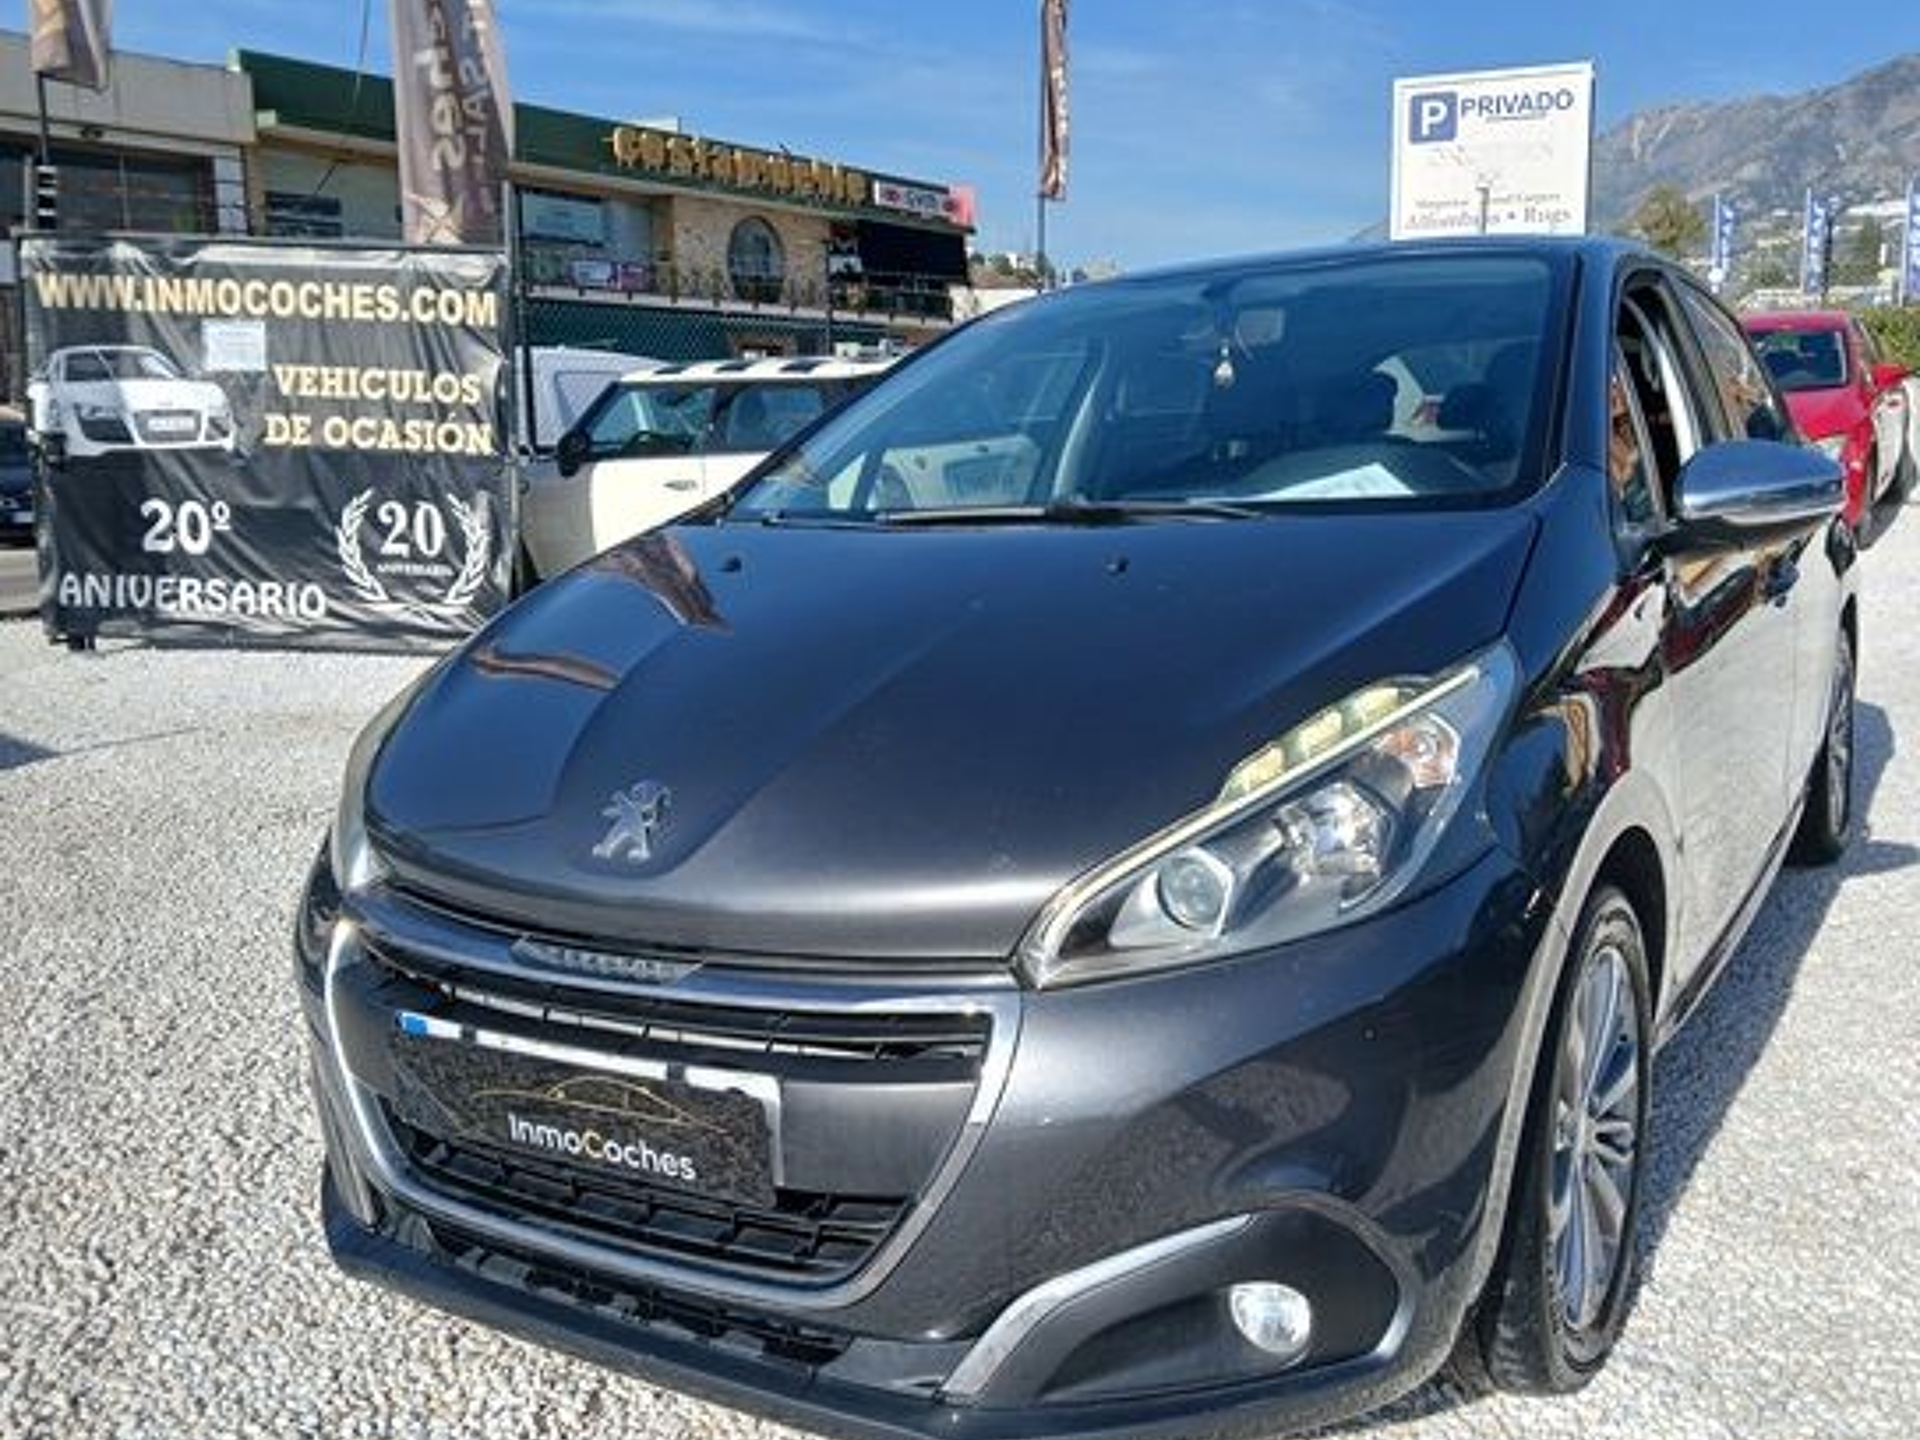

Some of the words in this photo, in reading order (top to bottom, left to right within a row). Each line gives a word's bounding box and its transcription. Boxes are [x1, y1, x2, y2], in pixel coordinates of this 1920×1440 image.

[1421, 101, 1449, 136] P
[1460, 88, 1575, 118] PRIVADO
[35, 271, 497, 327] WWW.INMOCOCHES.COM
[272, 363, 482, 404] VEHICULOS
[264, 413, 312, 446] DE
[323, 411, 497, 456] OCASIÓN
[377, 500, 448, 558] 20
[58, 572, 327, 618] ANIVERSARIO
[507, 1111, 697, 1181] InmoCoches
